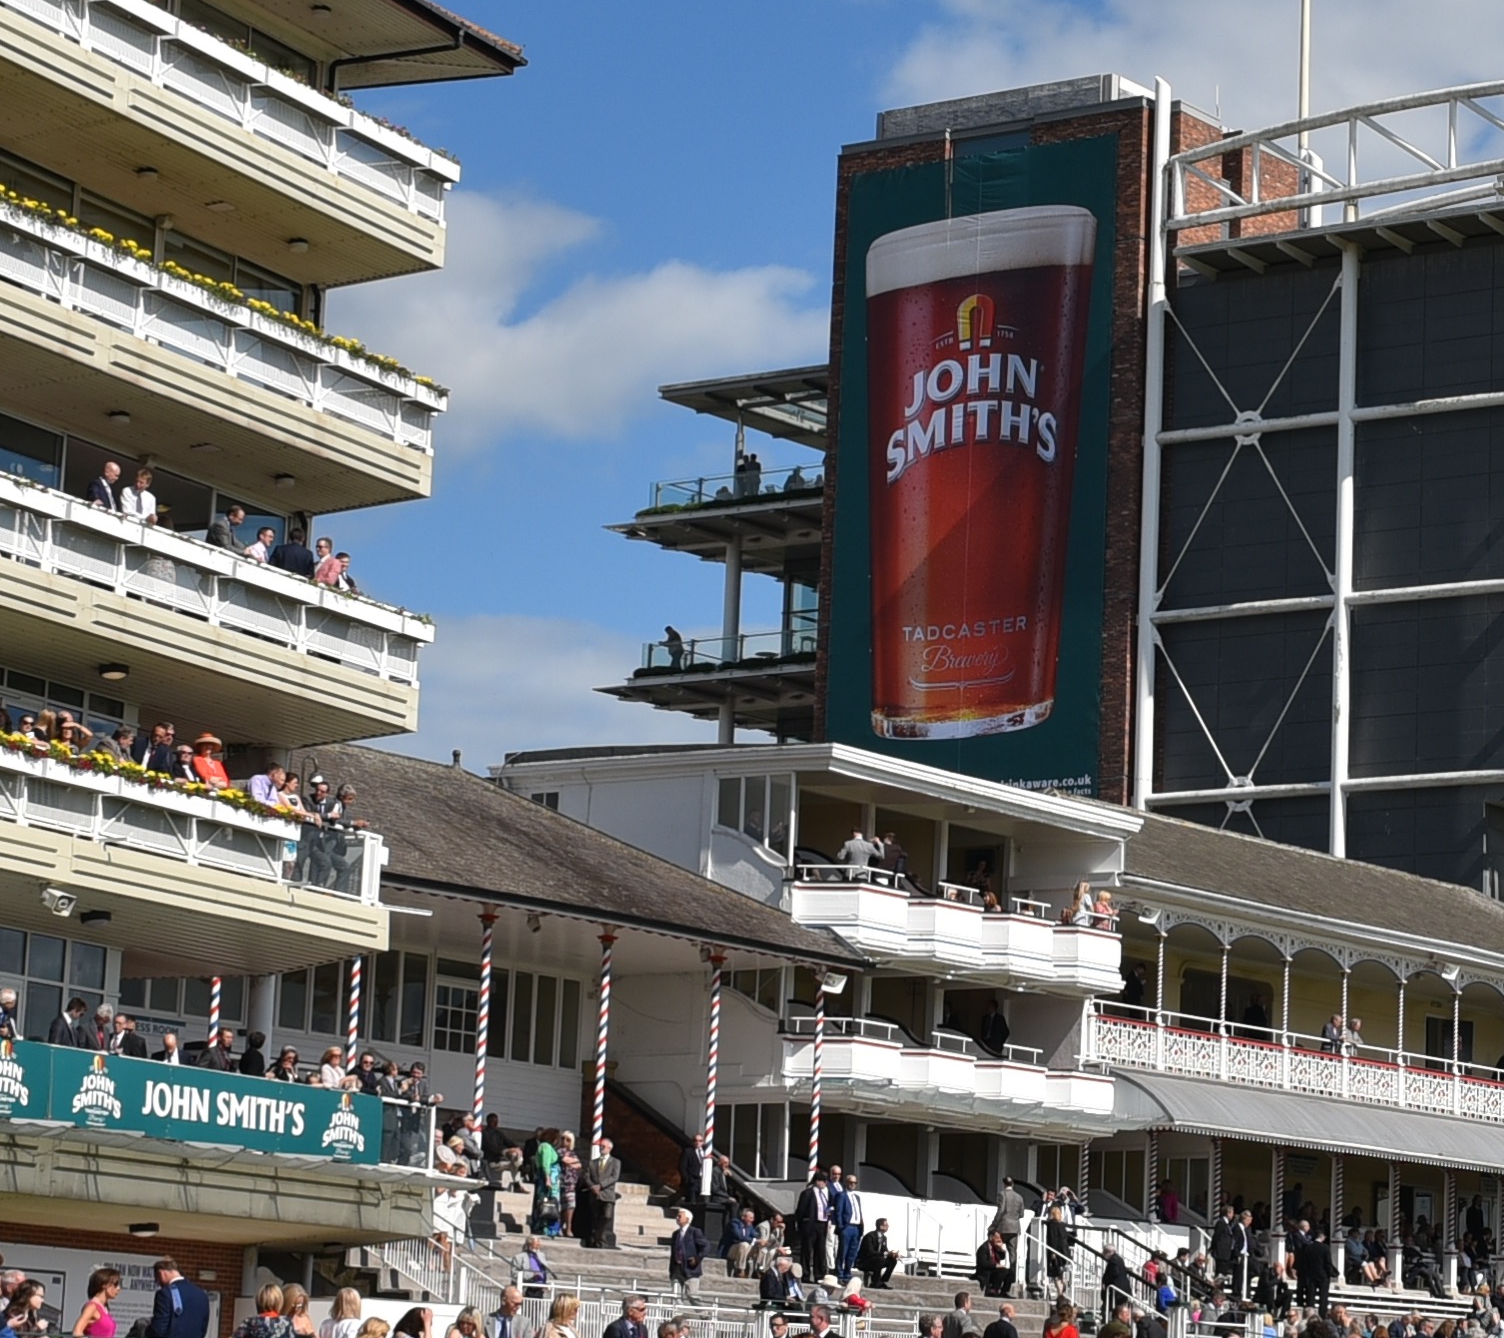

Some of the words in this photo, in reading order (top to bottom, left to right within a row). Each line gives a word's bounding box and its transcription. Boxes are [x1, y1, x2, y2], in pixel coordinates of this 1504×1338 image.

[904, 353, 1038, 420] JOHN
[886, 400, 1058, 486] SMITH'S
[902, 615, 1028, 642] TADCASTER
[921, 645, 1009, 676] Brewery
[136, 1022, 151, 1033] ESS
[80, 1074, 115, 1095] JOHN
[72, 1091, 121, 1120] SMITH'S
[142, 1080, 211, 1123] JOHN
[216, 1091, 306, 1137] SMITH'S
[329, 1111, 359, 1129] JOHN
[321, 1125, 365, 1152] SMITH'S
